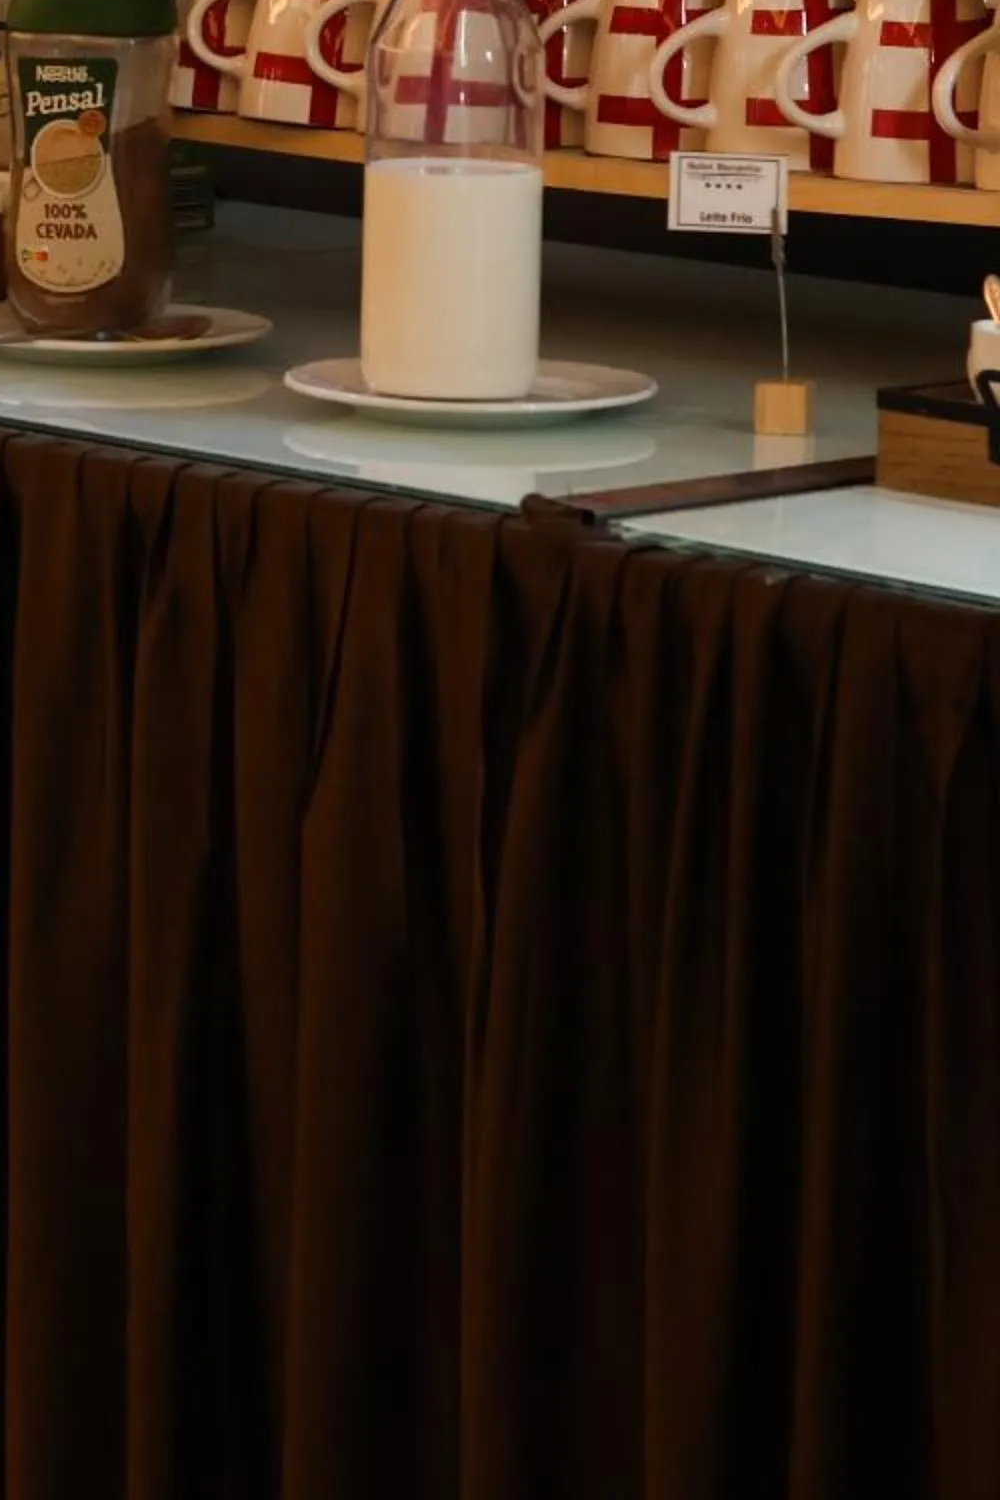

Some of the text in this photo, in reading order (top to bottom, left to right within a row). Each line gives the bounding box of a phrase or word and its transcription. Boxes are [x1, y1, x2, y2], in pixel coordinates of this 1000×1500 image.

[24, 81, 105, 117] Pensal
[43, 203, 88, 219] 100%
[36, 223, 98, 240] CEVADA
